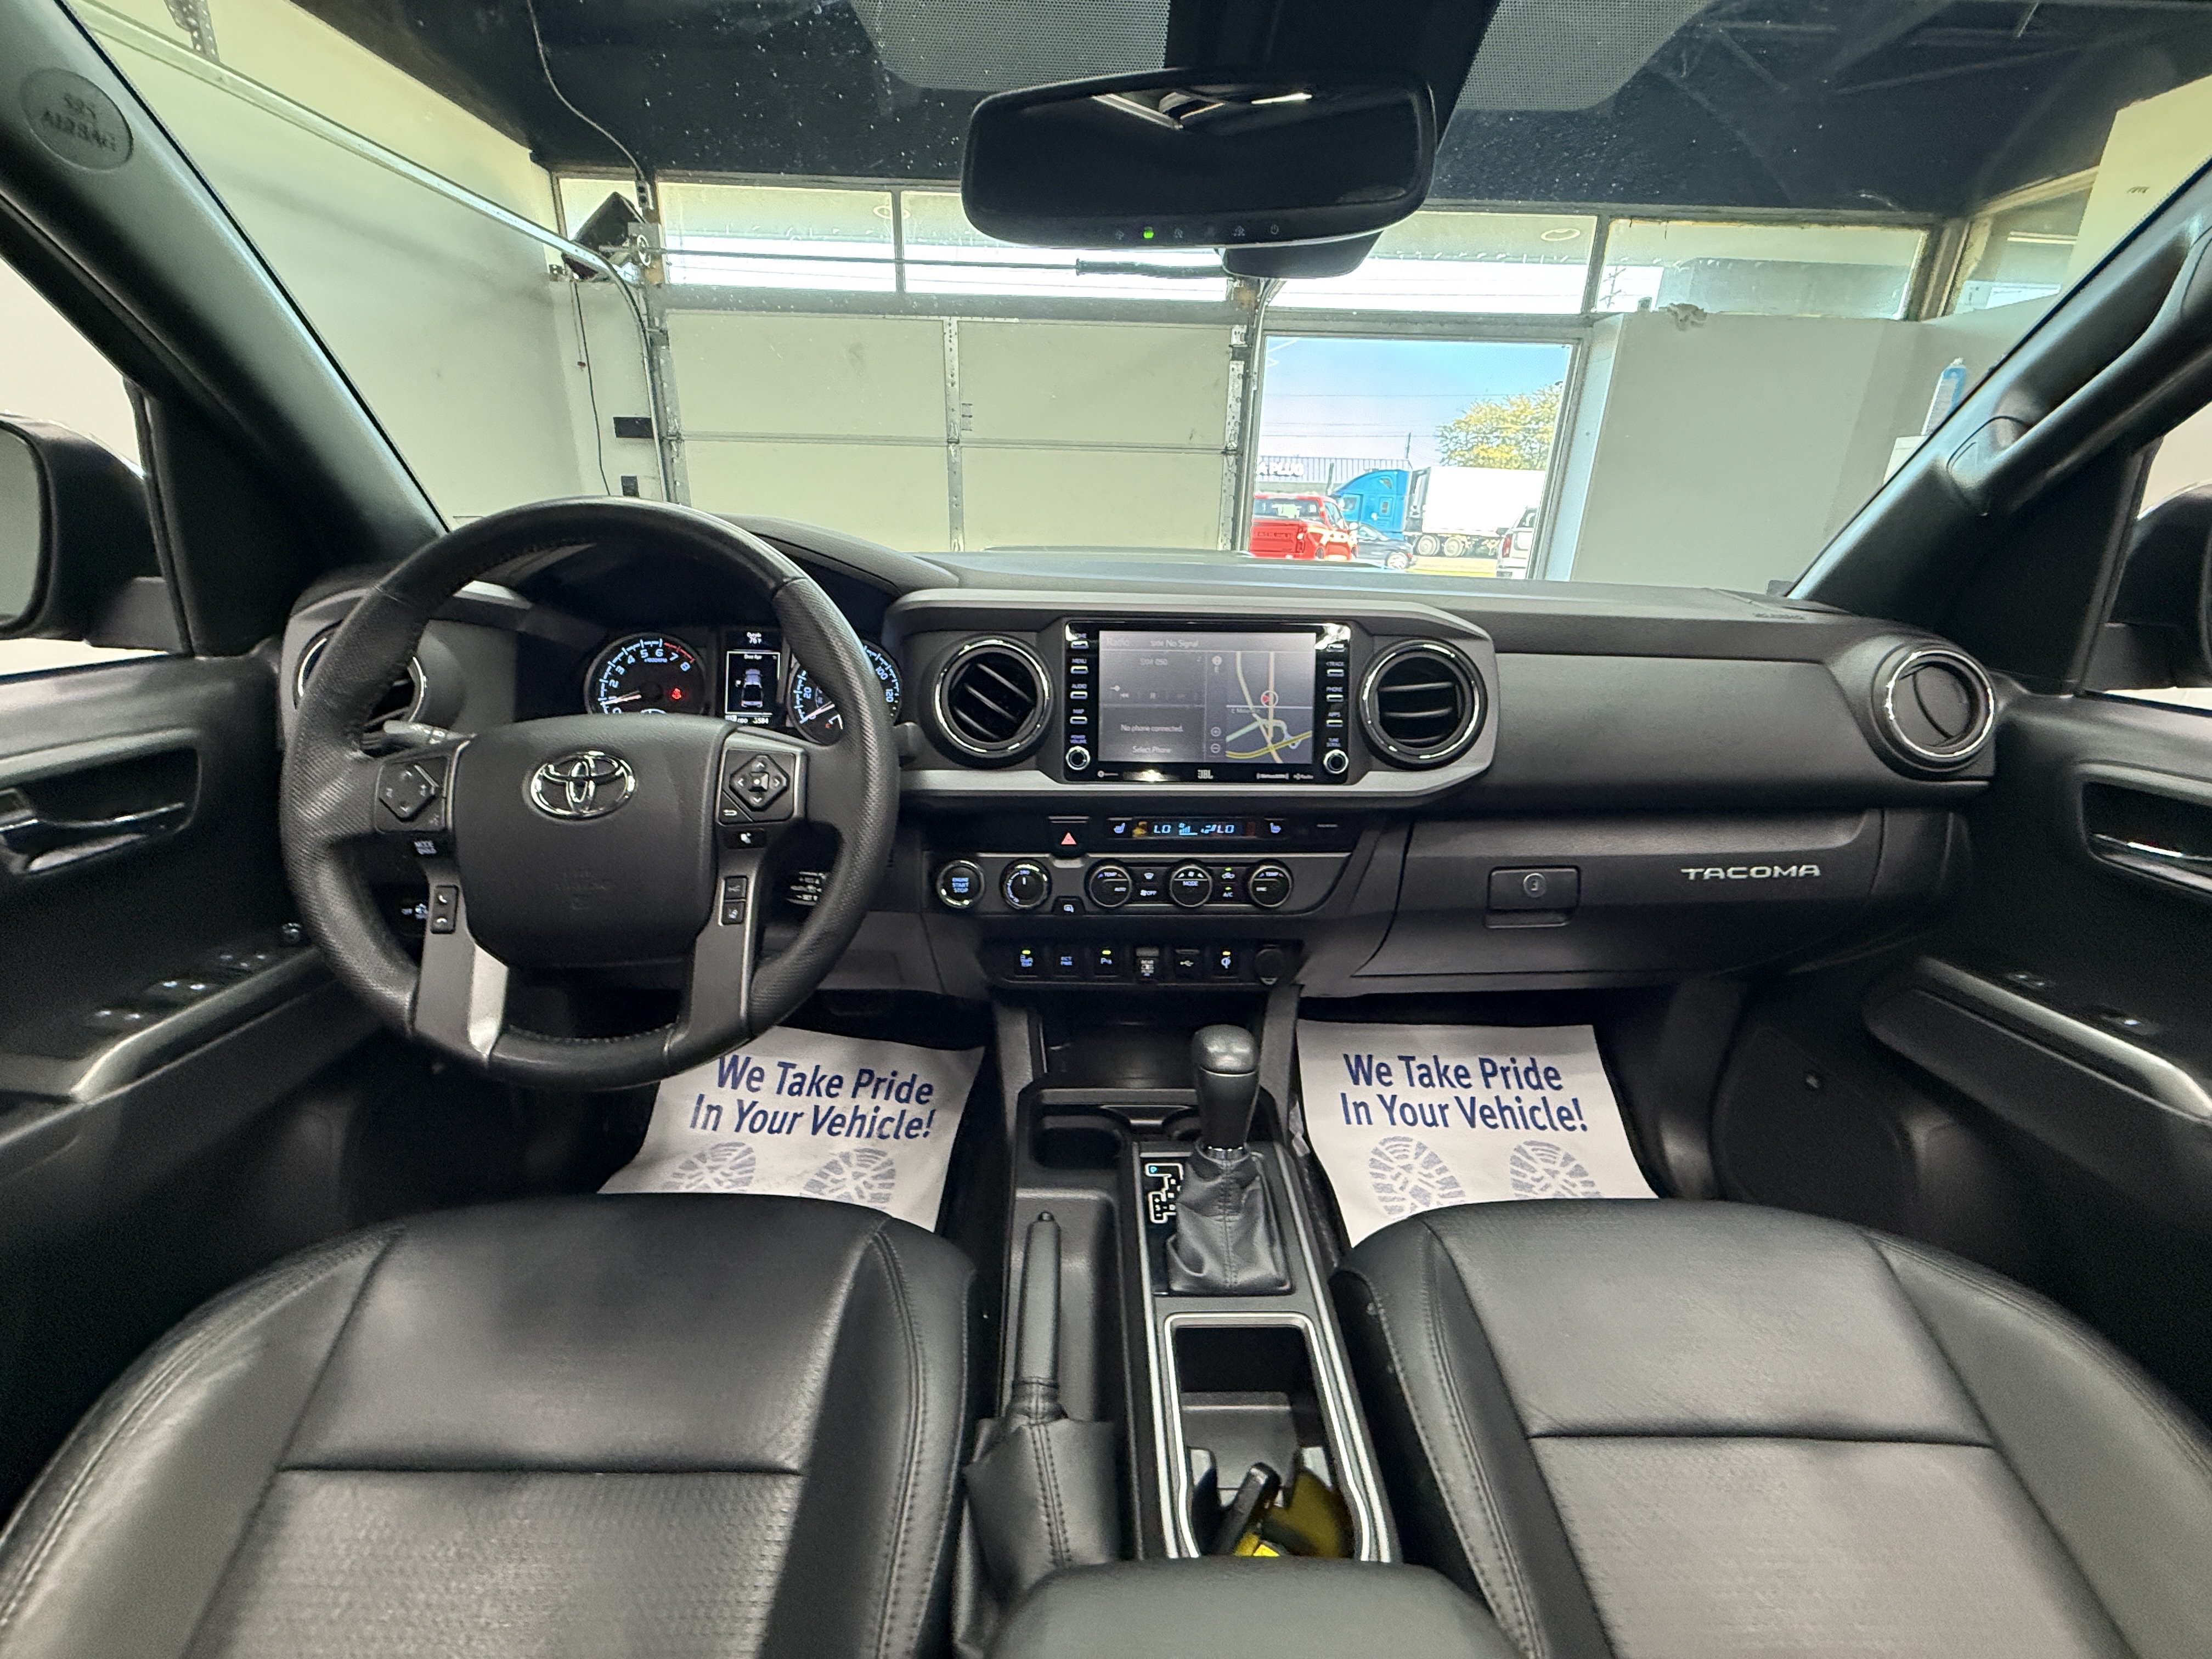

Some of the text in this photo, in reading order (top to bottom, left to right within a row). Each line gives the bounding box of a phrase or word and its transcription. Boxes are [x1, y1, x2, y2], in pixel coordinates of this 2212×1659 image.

[627, 655, 635, 664] 4
[640, 649, 648, 658] 5
[670, 652, 679, 661] 7
[615, 665, 625, 675] 3
[680, 662, 690, 672] 8
[876, 666, 889, 680] 100
[609, 679, 619, 688] 2
[803, 687, 812, 699] 20
[885, 689, 894, 702] 120
[1197, 769, 1214, 779] JBL
[1680, 864, 1821, 881] TACOMA
[1343, 1054, 1564, 1091] We Take Pride
[716, 1054, 933, 1104] We Take Pride
[690, 1093, 935, 1139] In Your Vehicle!
[1340, 1092, 1588, 1132] In Your Vehicle!
